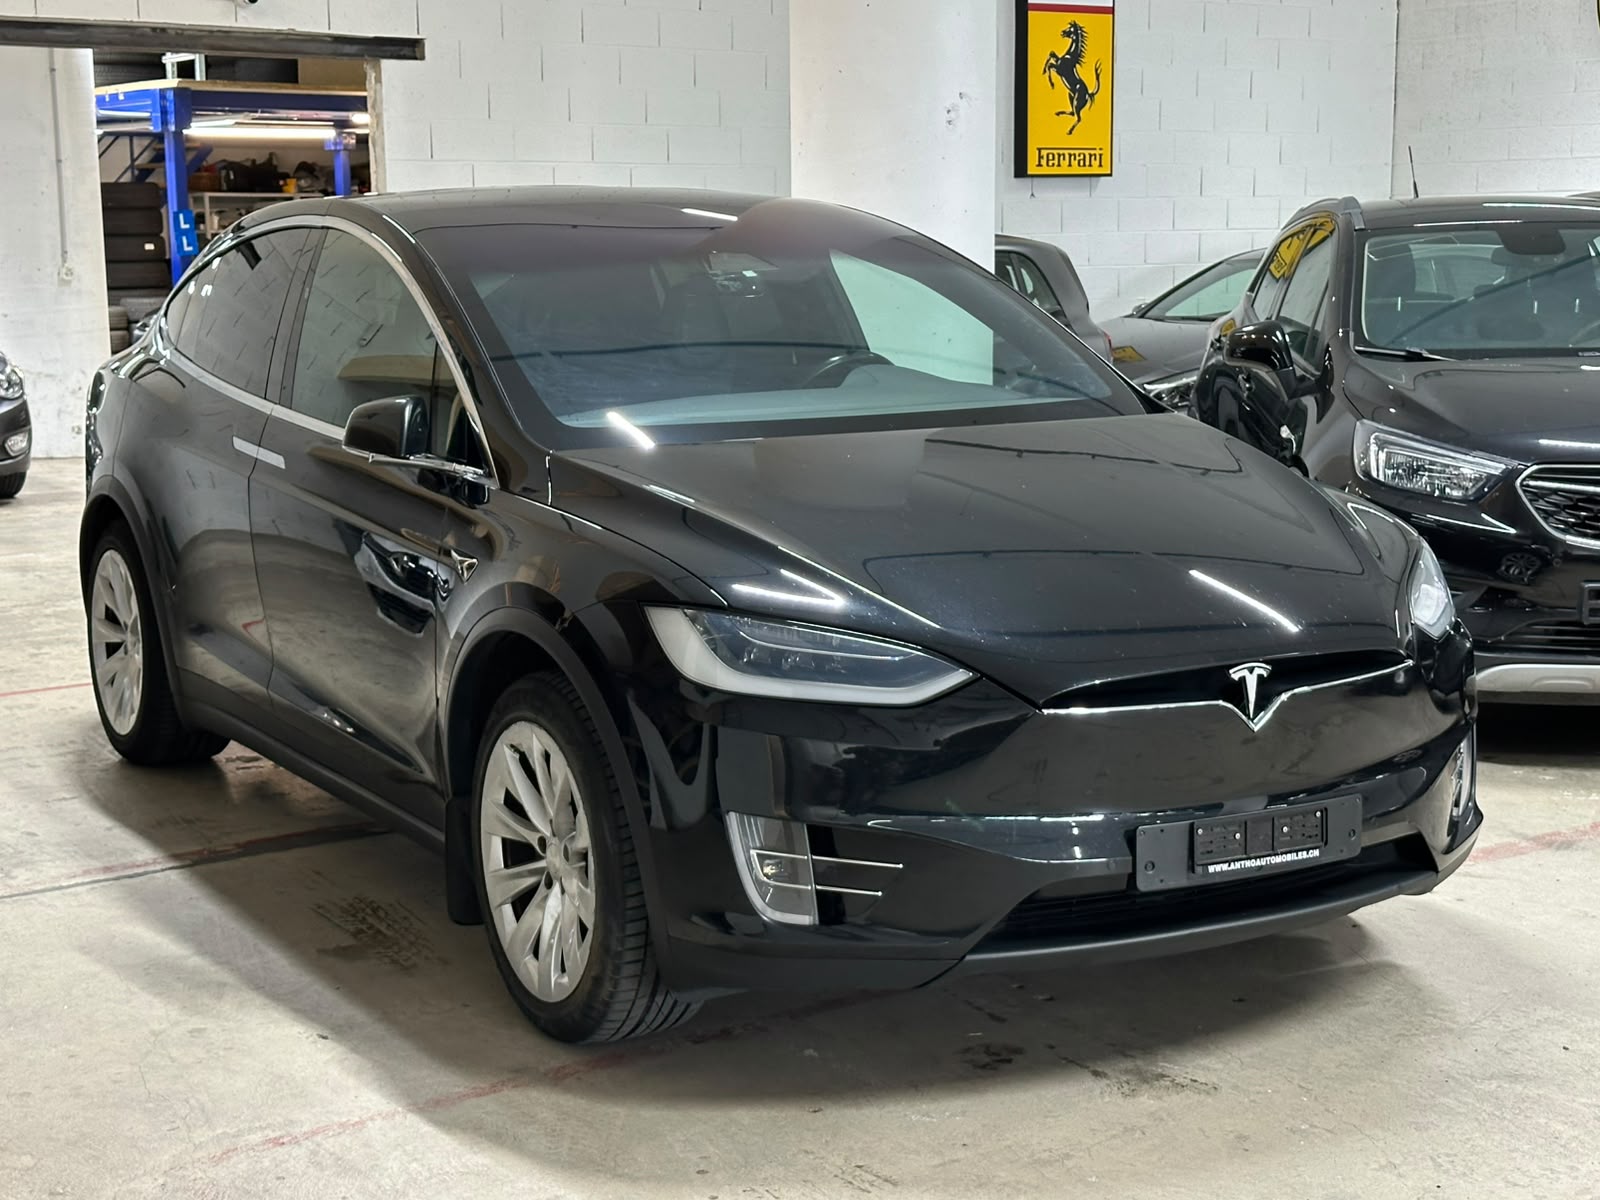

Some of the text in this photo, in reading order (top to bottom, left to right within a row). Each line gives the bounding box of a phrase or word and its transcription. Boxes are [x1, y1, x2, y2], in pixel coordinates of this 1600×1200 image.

[1036, 147, 1103, 168] Ferrari
[179, 213, 190, 229] L
[182, 235, 193, 251] L
